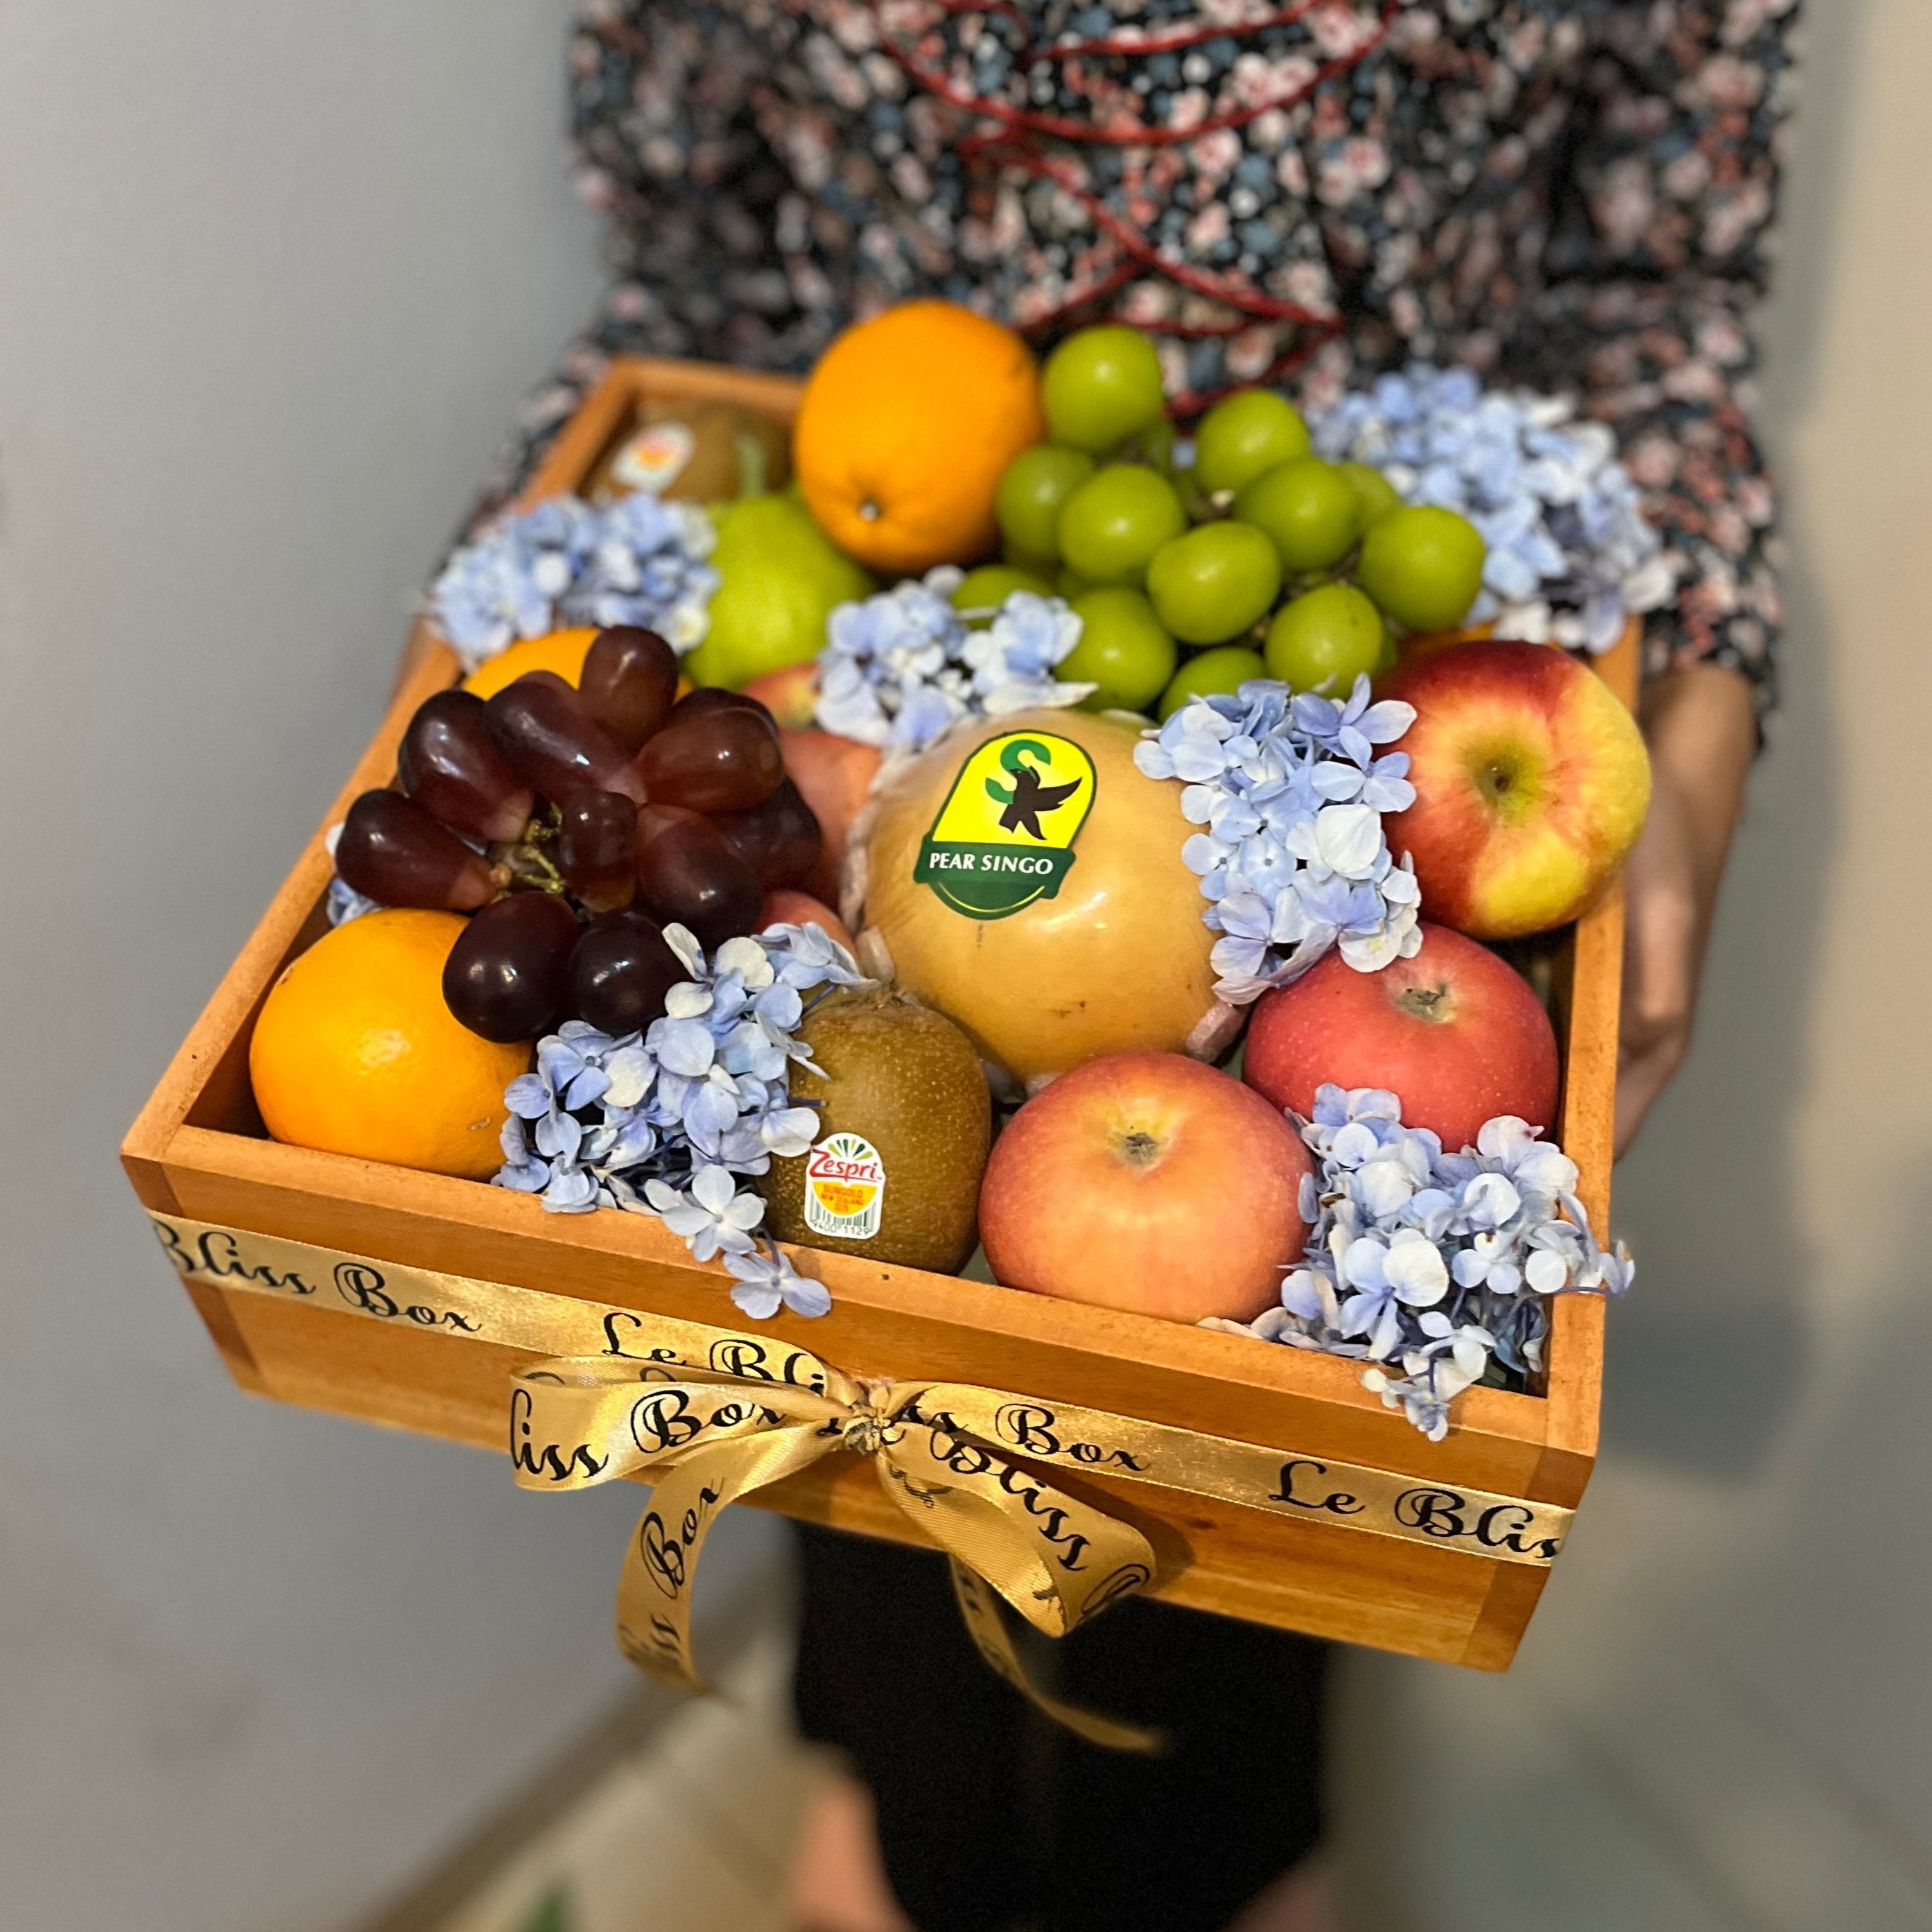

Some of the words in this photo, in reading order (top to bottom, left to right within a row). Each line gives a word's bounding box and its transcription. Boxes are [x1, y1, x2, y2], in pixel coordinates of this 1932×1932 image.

[929, 853, 975, 870] PEAR
[981, 854, 1054, 875] SINGO
[809, 1148, 878, 1182] Zespri
[333, 1262, 482, 1332] Box
[602, 1312, 686, 1366] Le
[995, 1402, 1151, 1472] Box
[1268, 1460, 1366, 1515] Le
[641, 1477, 725, 1600] Box
